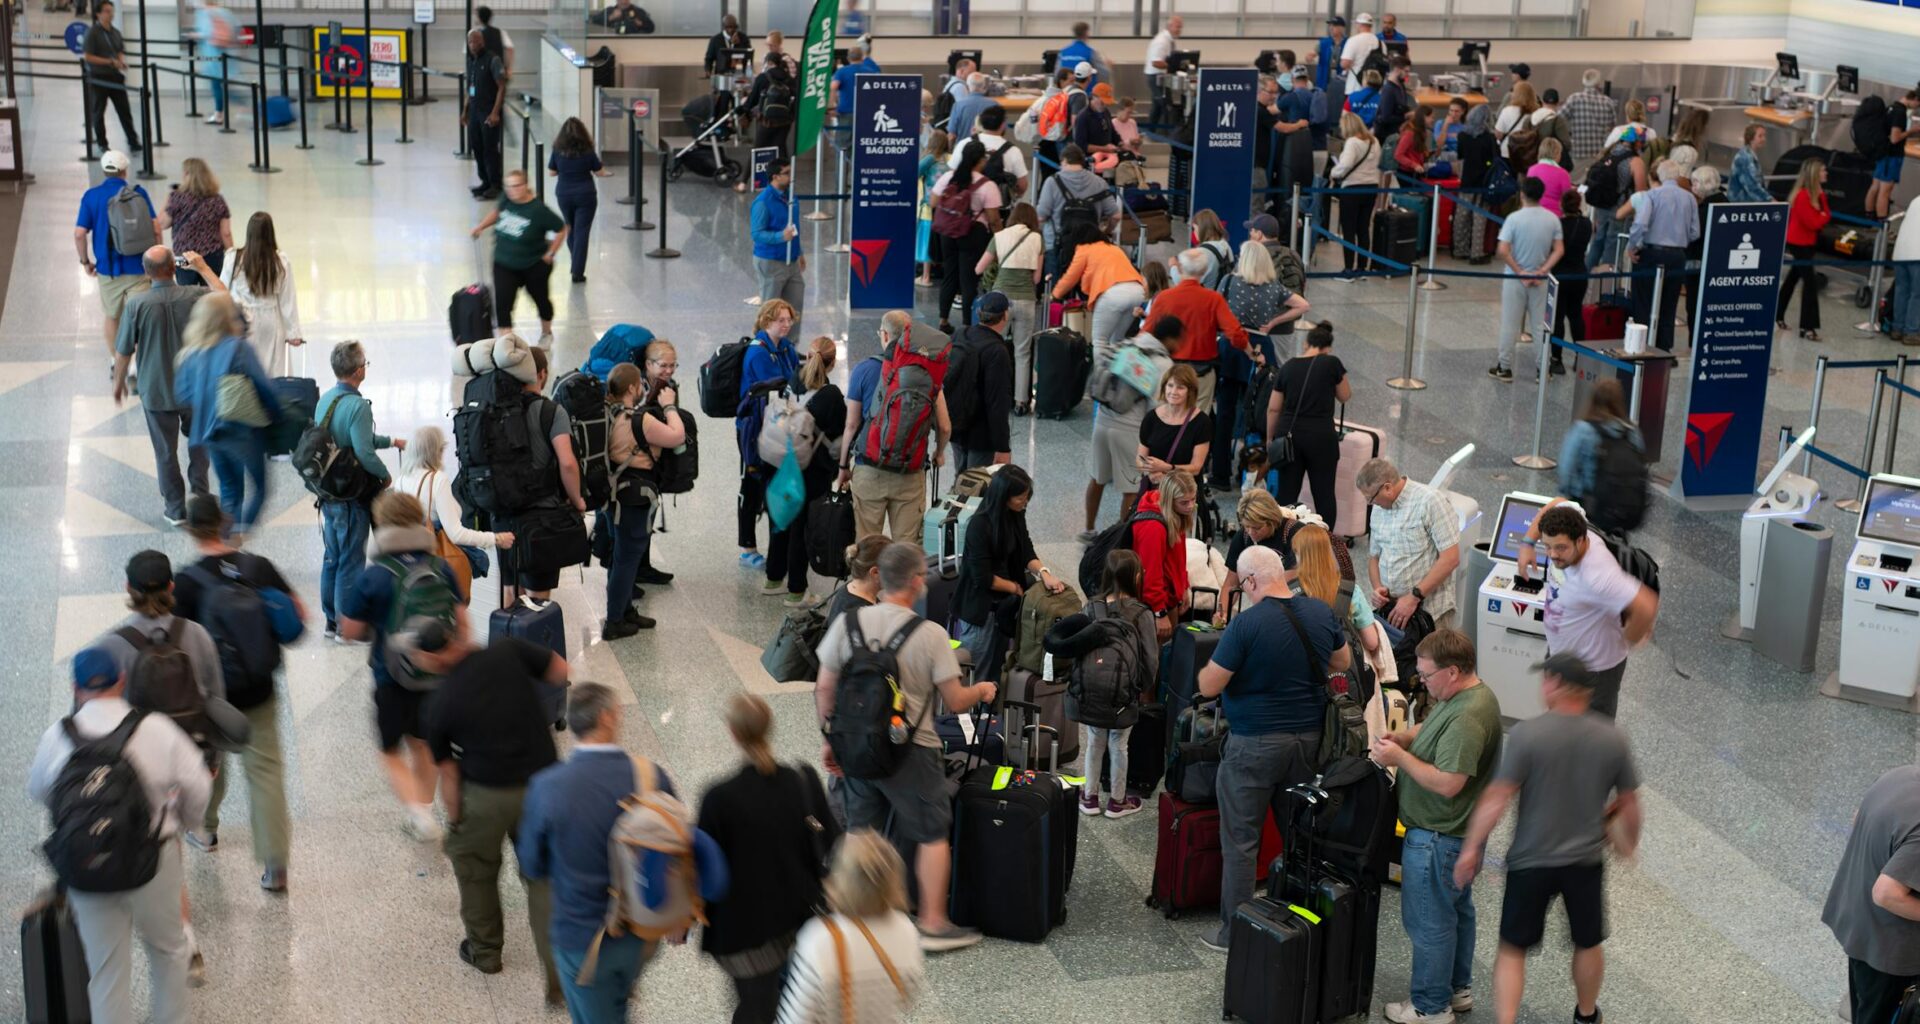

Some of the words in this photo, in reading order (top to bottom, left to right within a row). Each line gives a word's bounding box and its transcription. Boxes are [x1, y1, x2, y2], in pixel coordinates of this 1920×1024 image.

[372, 42, 393, 53] ZERO
[804, 41, 822, 98] DELTA
[873, 82, 907, 90] DELTA
[1209, 132, 1242, 140] OVERSIZE
[860, 138, 915, 146] SELF-SERVICE
[1209, 140, 1242, 148] BAGGAGE
[866, 147, 884, 155] BAG
[885, 147, 909, 155] DROP
[1731, 212, 1769, 222] DELTA
[1709, 276, 1741, 287] AGENT
[1742, 275, 1775, 286] ASSIST
[1707, 304, 1734, 312] SERVICES
[1735, 302, 1763, 311] OFFERED:
[1709, 372, 1724, 380] Agent
[1868, 622, 1899, 633] DELTA
[1501, 648, 1531, 658] DELTA
